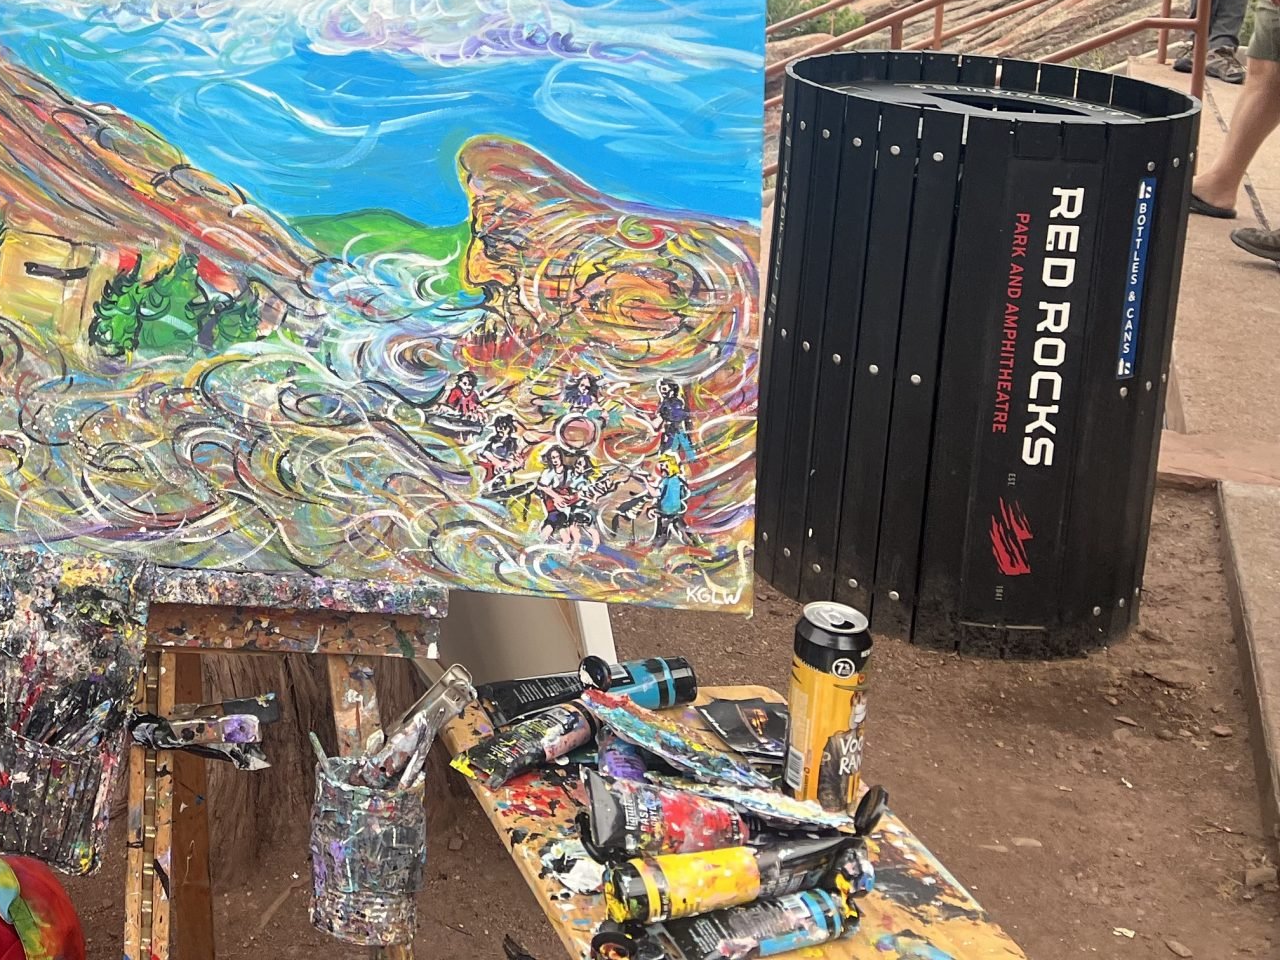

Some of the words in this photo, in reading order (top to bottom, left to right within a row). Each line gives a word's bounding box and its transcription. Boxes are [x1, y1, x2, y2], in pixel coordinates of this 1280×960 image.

[1009, 212, 1030, 257] PARK
[1042, 187, 1084, 288] RED
[1130, 203, 1147, 284] BOTTLES
[1007, 262, 1023, 298] AND
[1128, 291, 1136, 302] &
[1123, 308, 1135, 354] CANS
[992, 302, 1019, 433] AMPHITHEATRE
[1022, 301, 1070, 466] ROCKS
[1008, 473, 1016, 486] EST.
[686, 582, 745, 605] KGLW
